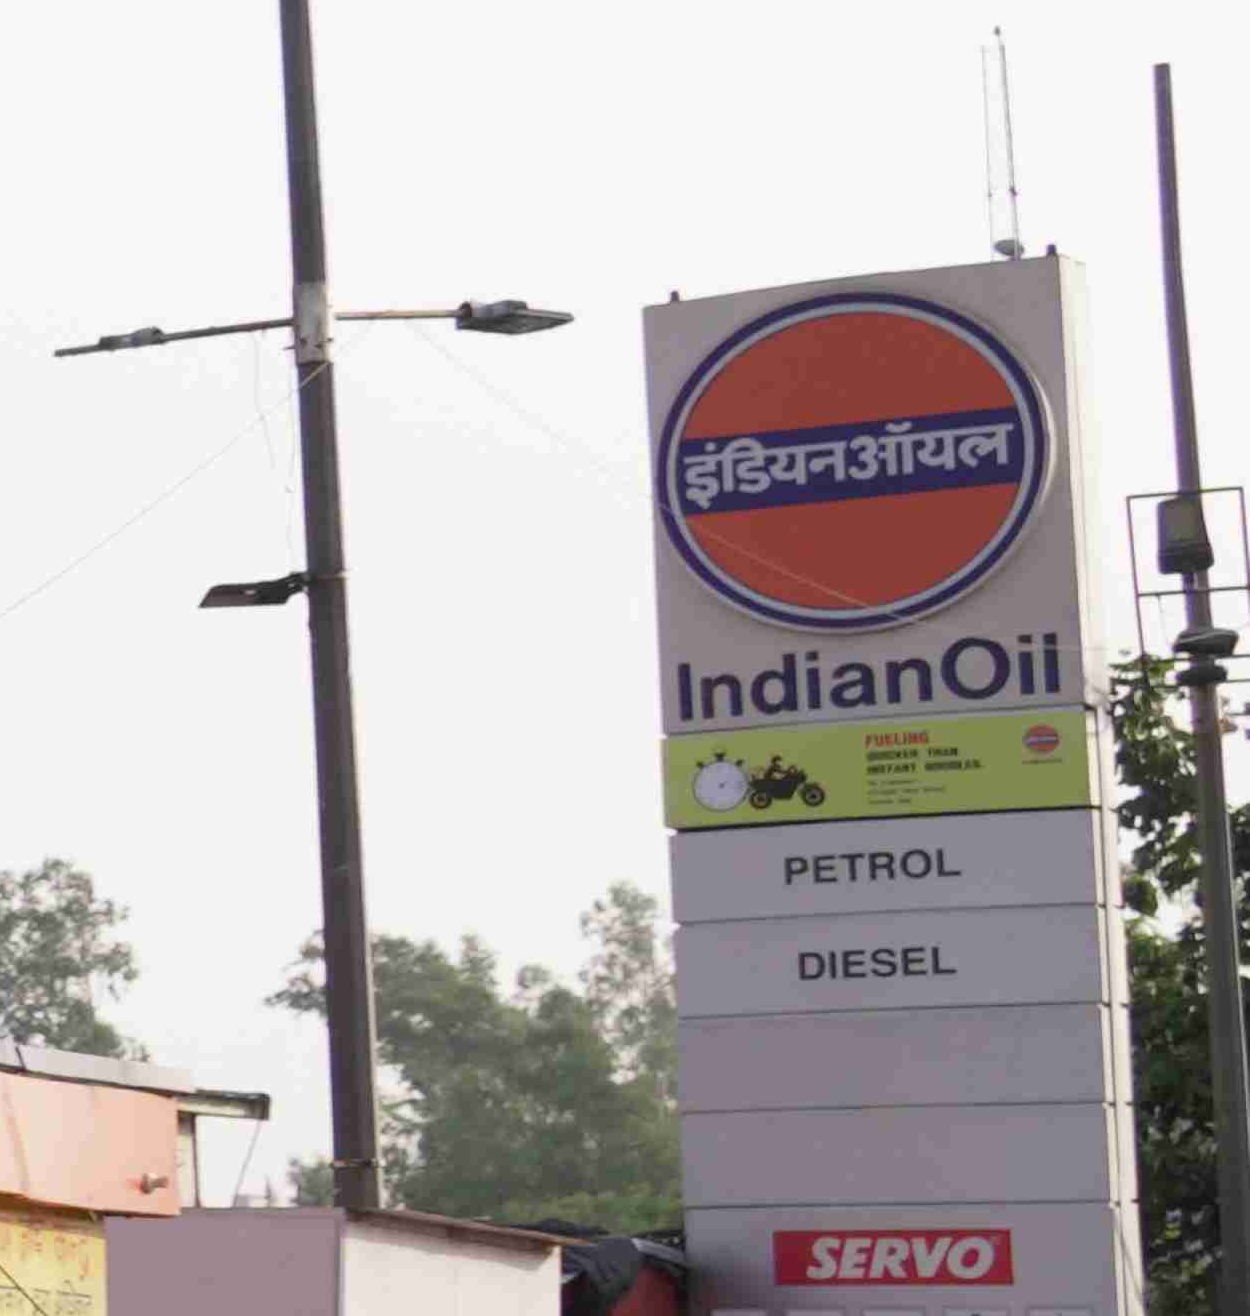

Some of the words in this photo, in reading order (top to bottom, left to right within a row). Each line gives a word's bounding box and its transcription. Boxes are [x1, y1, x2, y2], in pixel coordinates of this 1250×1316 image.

[684, 422, 1014, 510] इंडियनऑयल
[677, 633, 1062, 721] IndianOil
[784, 849, 962, 886] PETROL
[798, 946, 958, 981] DIESEL
[806, 1236, 994, 1279] SERVO
